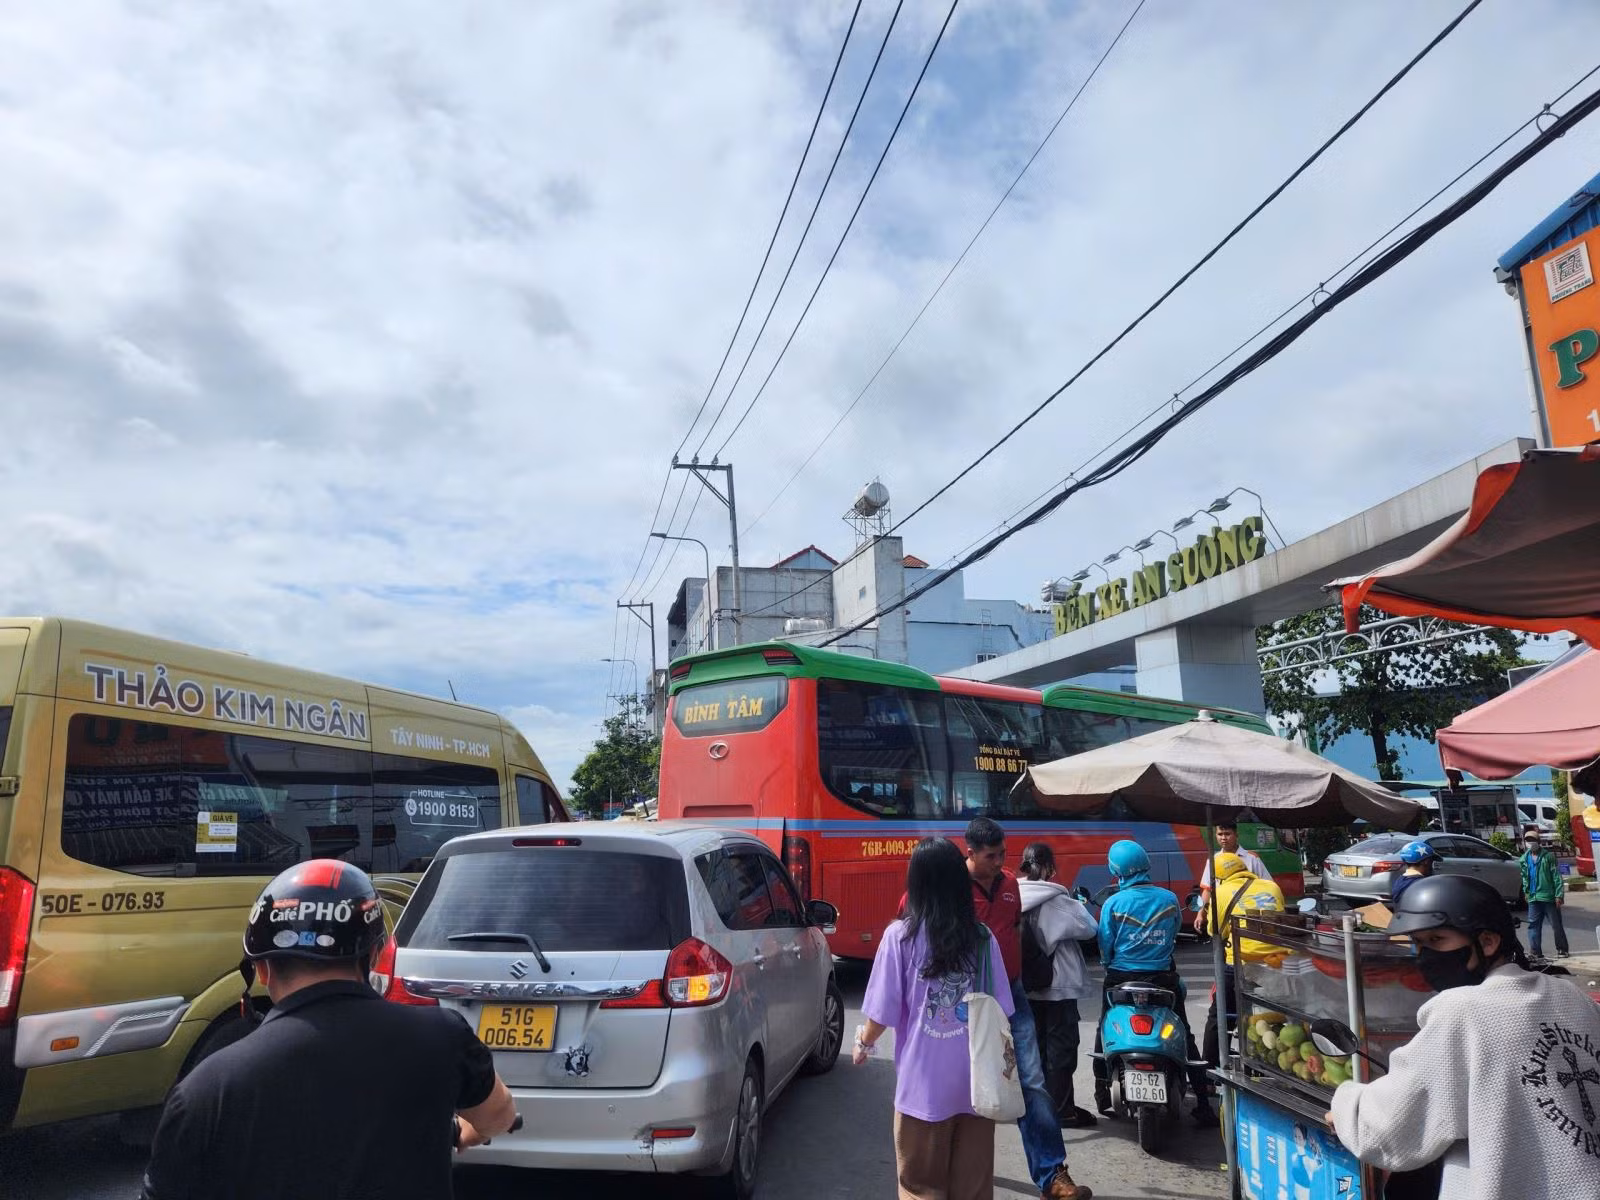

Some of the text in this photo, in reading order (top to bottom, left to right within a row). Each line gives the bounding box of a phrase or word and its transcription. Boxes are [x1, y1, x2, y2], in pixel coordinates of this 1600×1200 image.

[1548, 328, 1600, 389] P
[1053, 516, 1267, 637] BẾN XE AN SƯƠNG
[85, 662, 368, 740] THẢO KIM NGÂN
[684, 694, 763, 724] BÌNH TÂM
[390, 727, 413, 747] TÂY
[415, 732, 444, 751] NINH
[452, 738, 490, 758] TP.HCM
[974, 756, 994, 771] 1900
[995, 757, 1006, 772] 88
[1007, 758, 1018, 773] 66
[417, 788, 445, 799] HOTLINE
[418, 801, 475, 818] 1900 8153
[41, 894, 83, 914] 50E
[101, 891, 165, 912] 076.93
[298, 898, 352, 923] PHỐ
[472, 983, 564, 997] ERTIGA
[500, 1007, 535, 1026] 51G
[484, 1027, 545, 1047] 006.54
[1130, 1087, 1165, 1101] 182.60
